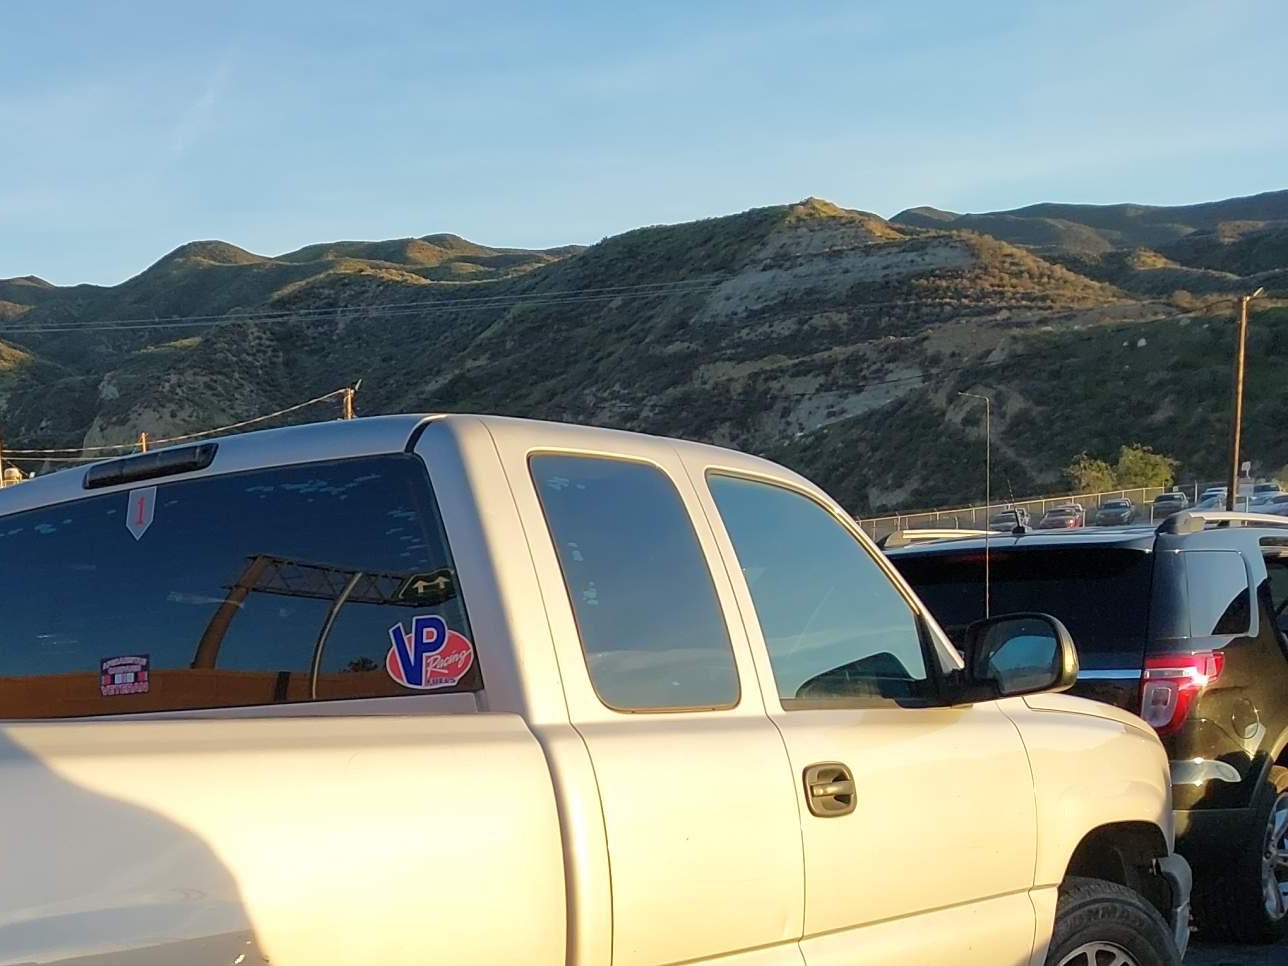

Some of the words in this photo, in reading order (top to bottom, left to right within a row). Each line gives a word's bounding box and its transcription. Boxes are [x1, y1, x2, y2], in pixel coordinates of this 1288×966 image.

[135, 495, 146, 526] 1
[390, 615, 447, 687] VP
[426, 647, 472, 679] Racing
